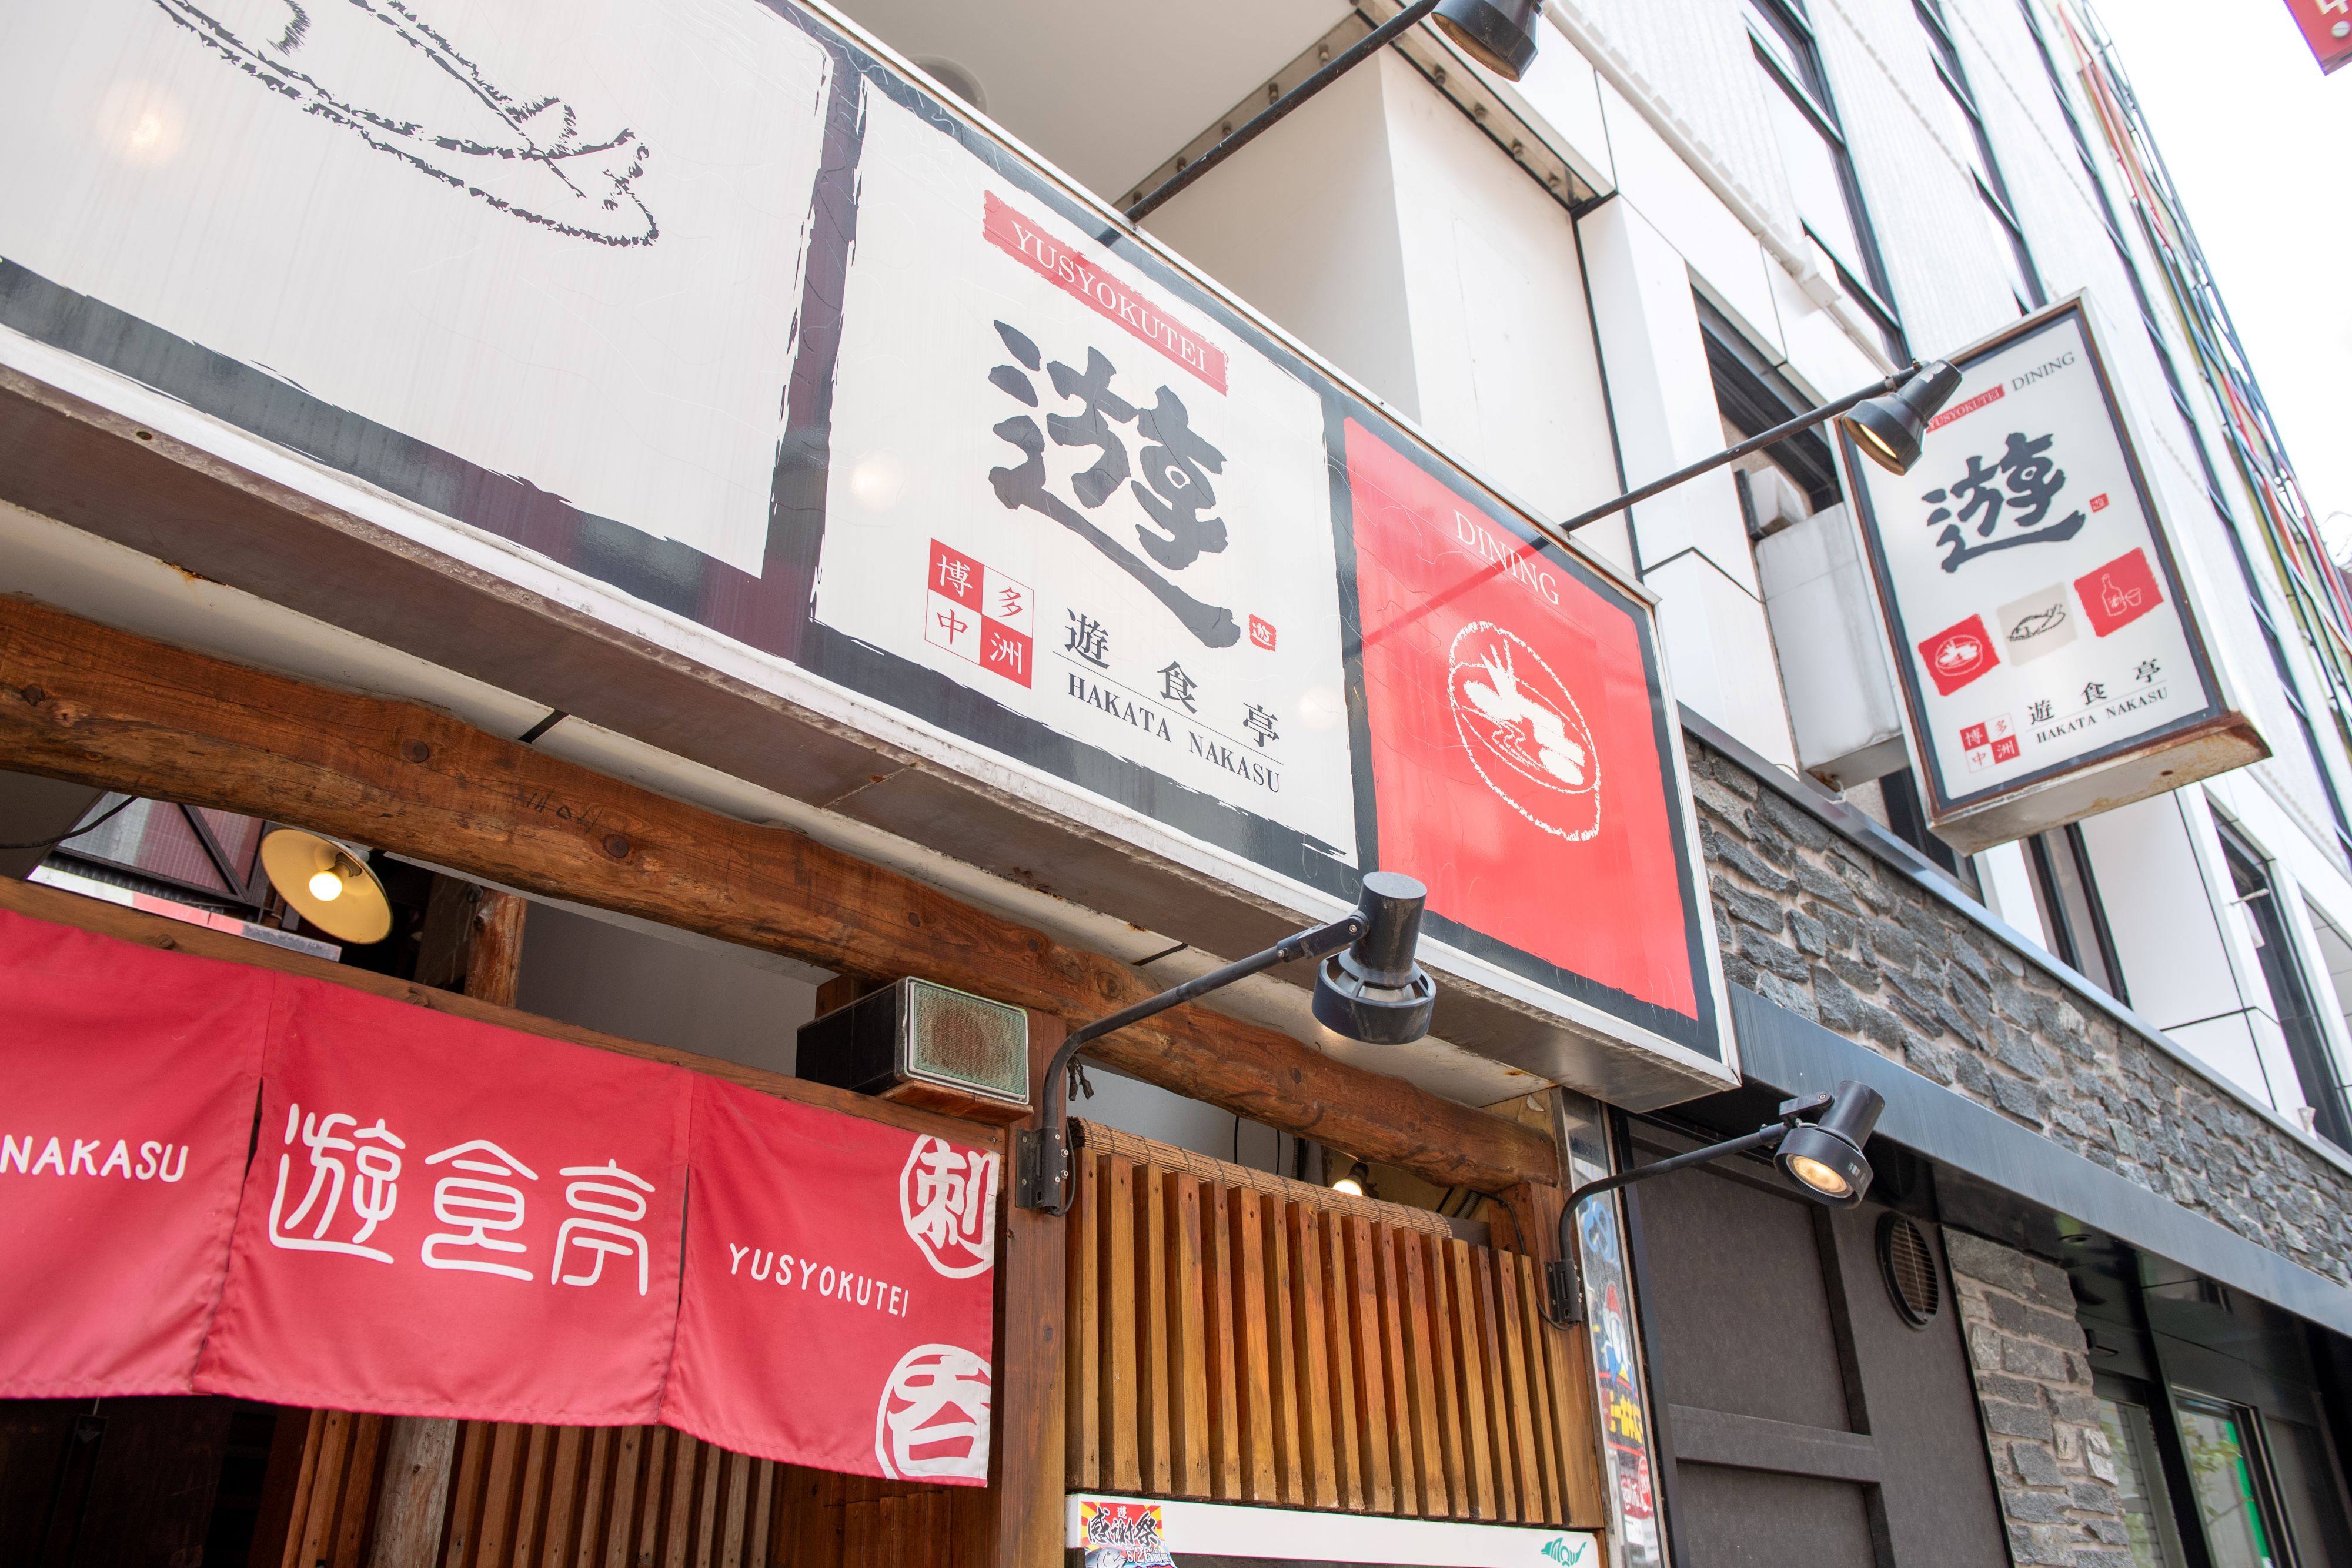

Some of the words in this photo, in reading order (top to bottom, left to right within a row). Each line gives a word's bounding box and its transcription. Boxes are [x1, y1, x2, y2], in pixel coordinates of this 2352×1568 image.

[1011, 220, 1207, 373] YUSYOKUTEI
[1929, 389, 2000, 429] YUSYOKUTEI
[2012, 351, 2076, 392] DINING
[1453, 509, 1559, 605] DINING
[1068, 673, 1172, 743] HAKATA
[1189, 731, 1281, 793] NAKASU
[2037, 716, 2097, 744] HAKATA
[2106, 687, 2169, 717] NAKASU
[0, 1134, 189, 1183] NAKASU
[729, 1243, 910, 1318] YUSYOKUTEI
[1088, 1506, 1159, 1546] 感謝祭
